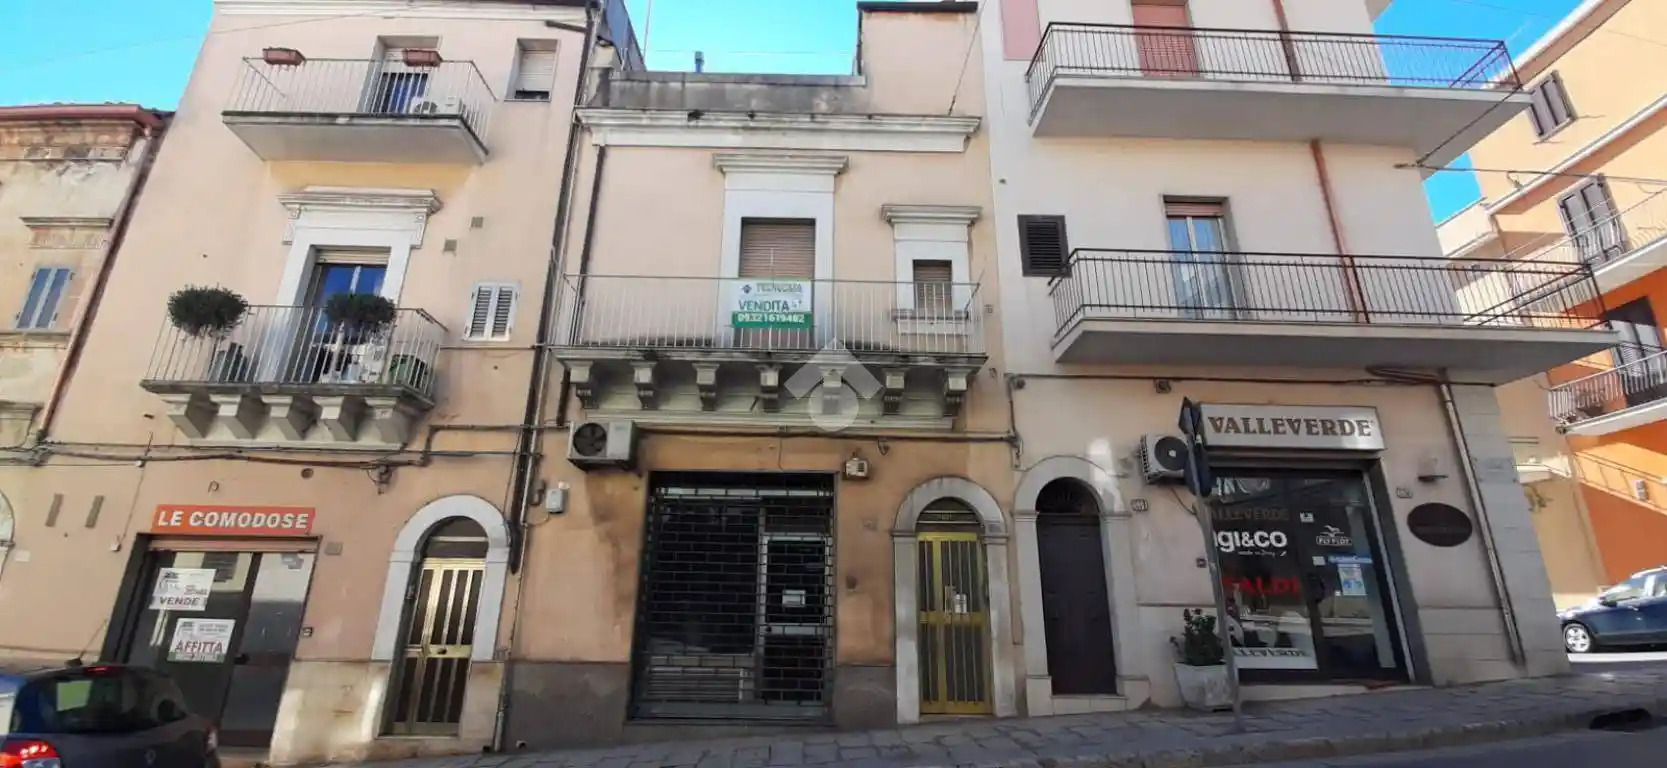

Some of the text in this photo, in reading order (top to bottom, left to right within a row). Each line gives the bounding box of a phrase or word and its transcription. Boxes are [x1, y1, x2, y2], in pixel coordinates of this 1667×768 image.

[738, 299, 790, 312] VENDITA
[1207, 416, 1372, 437] VALLEVERDE
[157, 510, 309, 529] LE COMODOSE
[160, 596, 201, 606] VENDE
[175, 640, 223, 654] AFFITTA
